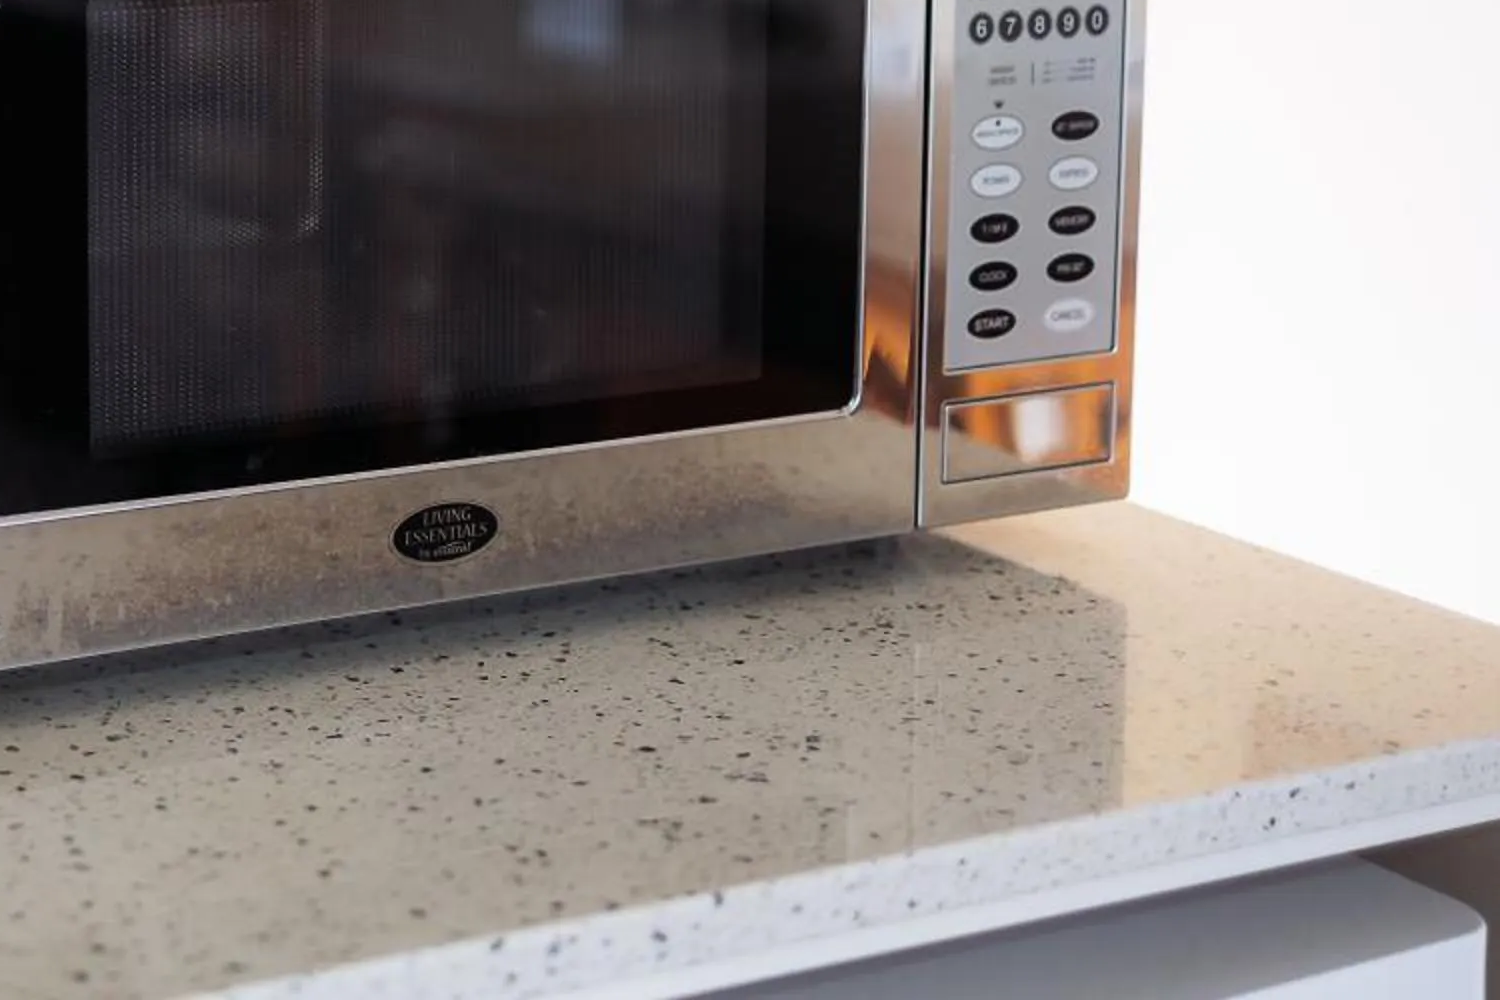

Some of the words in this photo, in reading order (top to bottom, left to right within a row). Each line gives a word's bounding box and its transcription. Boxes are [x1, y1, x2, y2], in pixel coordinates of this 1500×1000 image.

[976, 18, 987, 38] 6
[1005, 16, 1017, 36] 7
[1034, 14, 1046, 34] 8
[1063, 13, 1075, 32] 9
[1091, 10, 1103, 30] 0
[974, 315, 1010, 333] START
[422, 505, 472, 527] LIVING
[404, 522, 489, 546] ESSENTIALS
